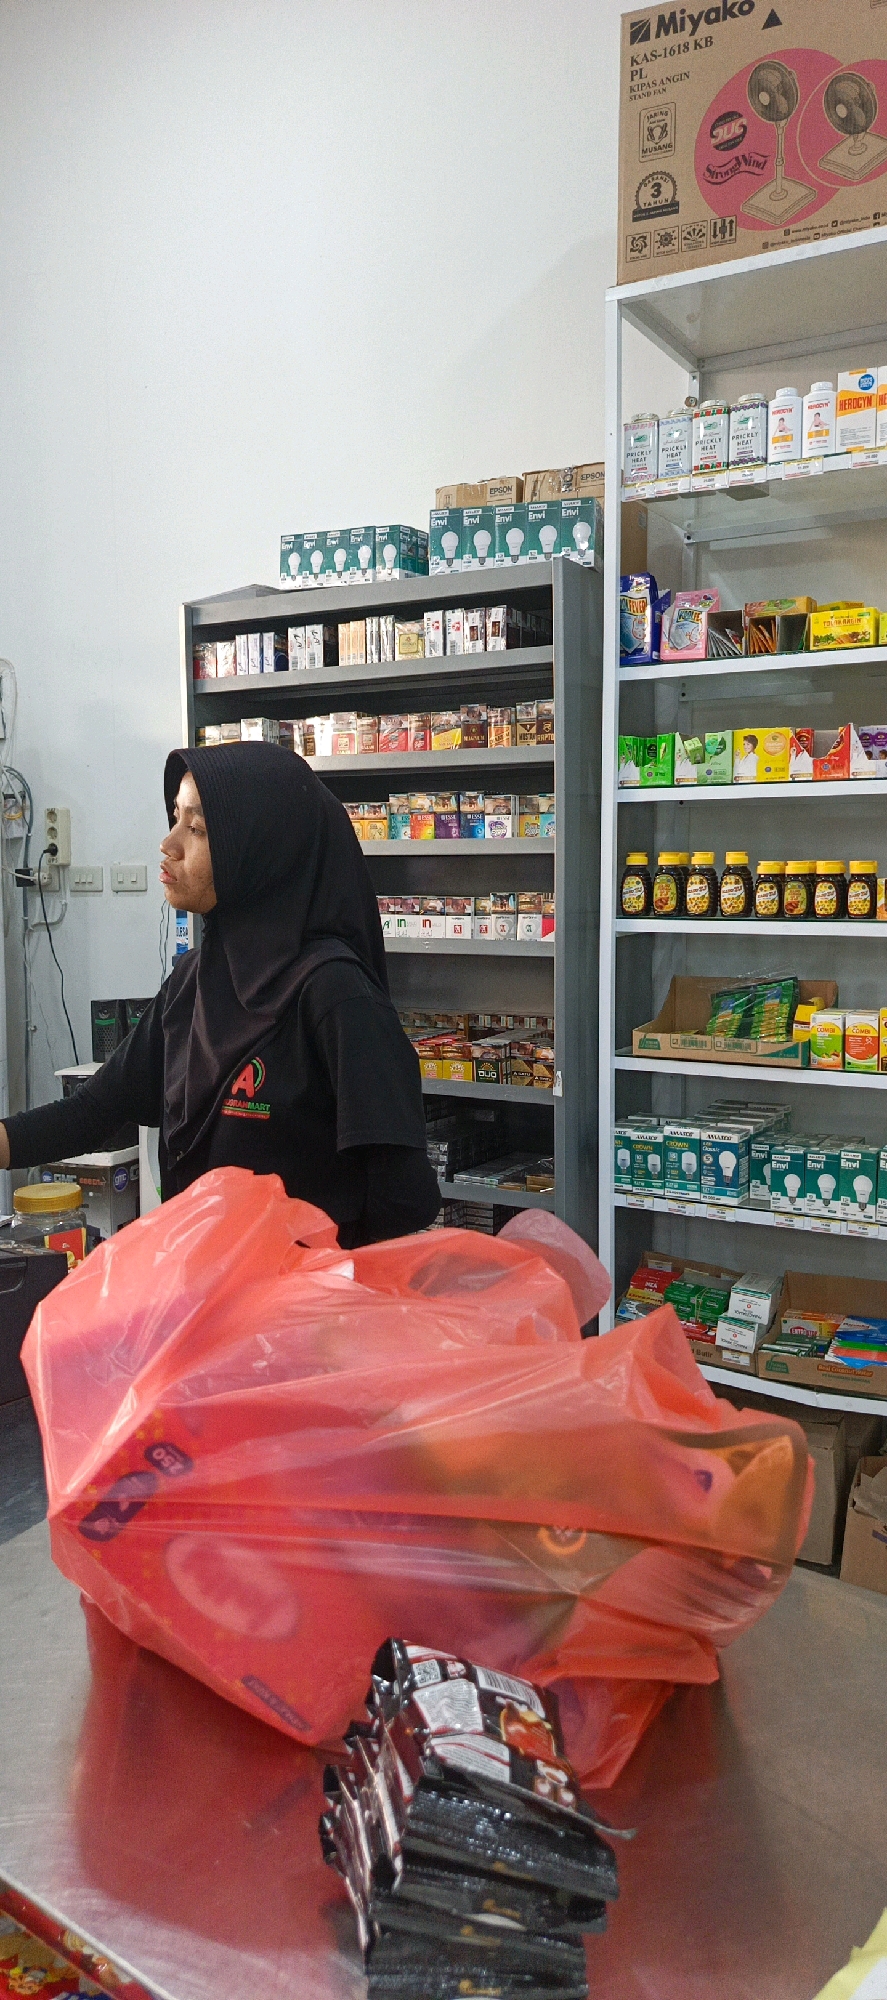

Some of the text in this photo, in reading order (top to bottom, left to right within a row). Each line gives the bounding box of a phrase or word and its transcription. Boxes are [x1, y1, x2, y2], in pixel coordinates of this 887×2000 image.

[655, 0, 755, 39] Miyako
[630, 35, 714, 67] KAS-1618 KB
[630, 68, 648, 82] PL
[629, 71, 690, 94] KIPAS ANGIN
[629, 86, 667, 102] STAND FAN
[646, 110, 669, 122] JARING
[641, 142, 673, 155] MUSANG
[650, 182, 662, 199] 3
[643, 198, 669, 208] TAHUN
[839, 395, 873, 412] HEROCYN
[732, 432, 759, 441] PRICKLY
[695, 438, 722, 446] PRICKLY
[626, 449, 652, 458] PRICKLY
[661, 445, 687, 453] PRICKLY
[581, 471, 605, 481] EPSON
[489, 485, 513, 495] EPSON
[528, 511, 546, 520] Envi
[561, 507, 579, 517] Envi
[430, 517, 448, 526] Envi
[463, 516, 480, 525] Envi
[495, 514, 512, 523] Envi
[628, 599, 646, 614] FEVER
[537, 733, 554, 741] RAPTO
[751, 1150, 767, 1158] Envi
[772, 1160, 789, 1169] Envi
[807, 1160, 824, 1169] Envi
[840, 1158, 860, 1168] Envi
[115, 1173, 127, 1186] gmc
